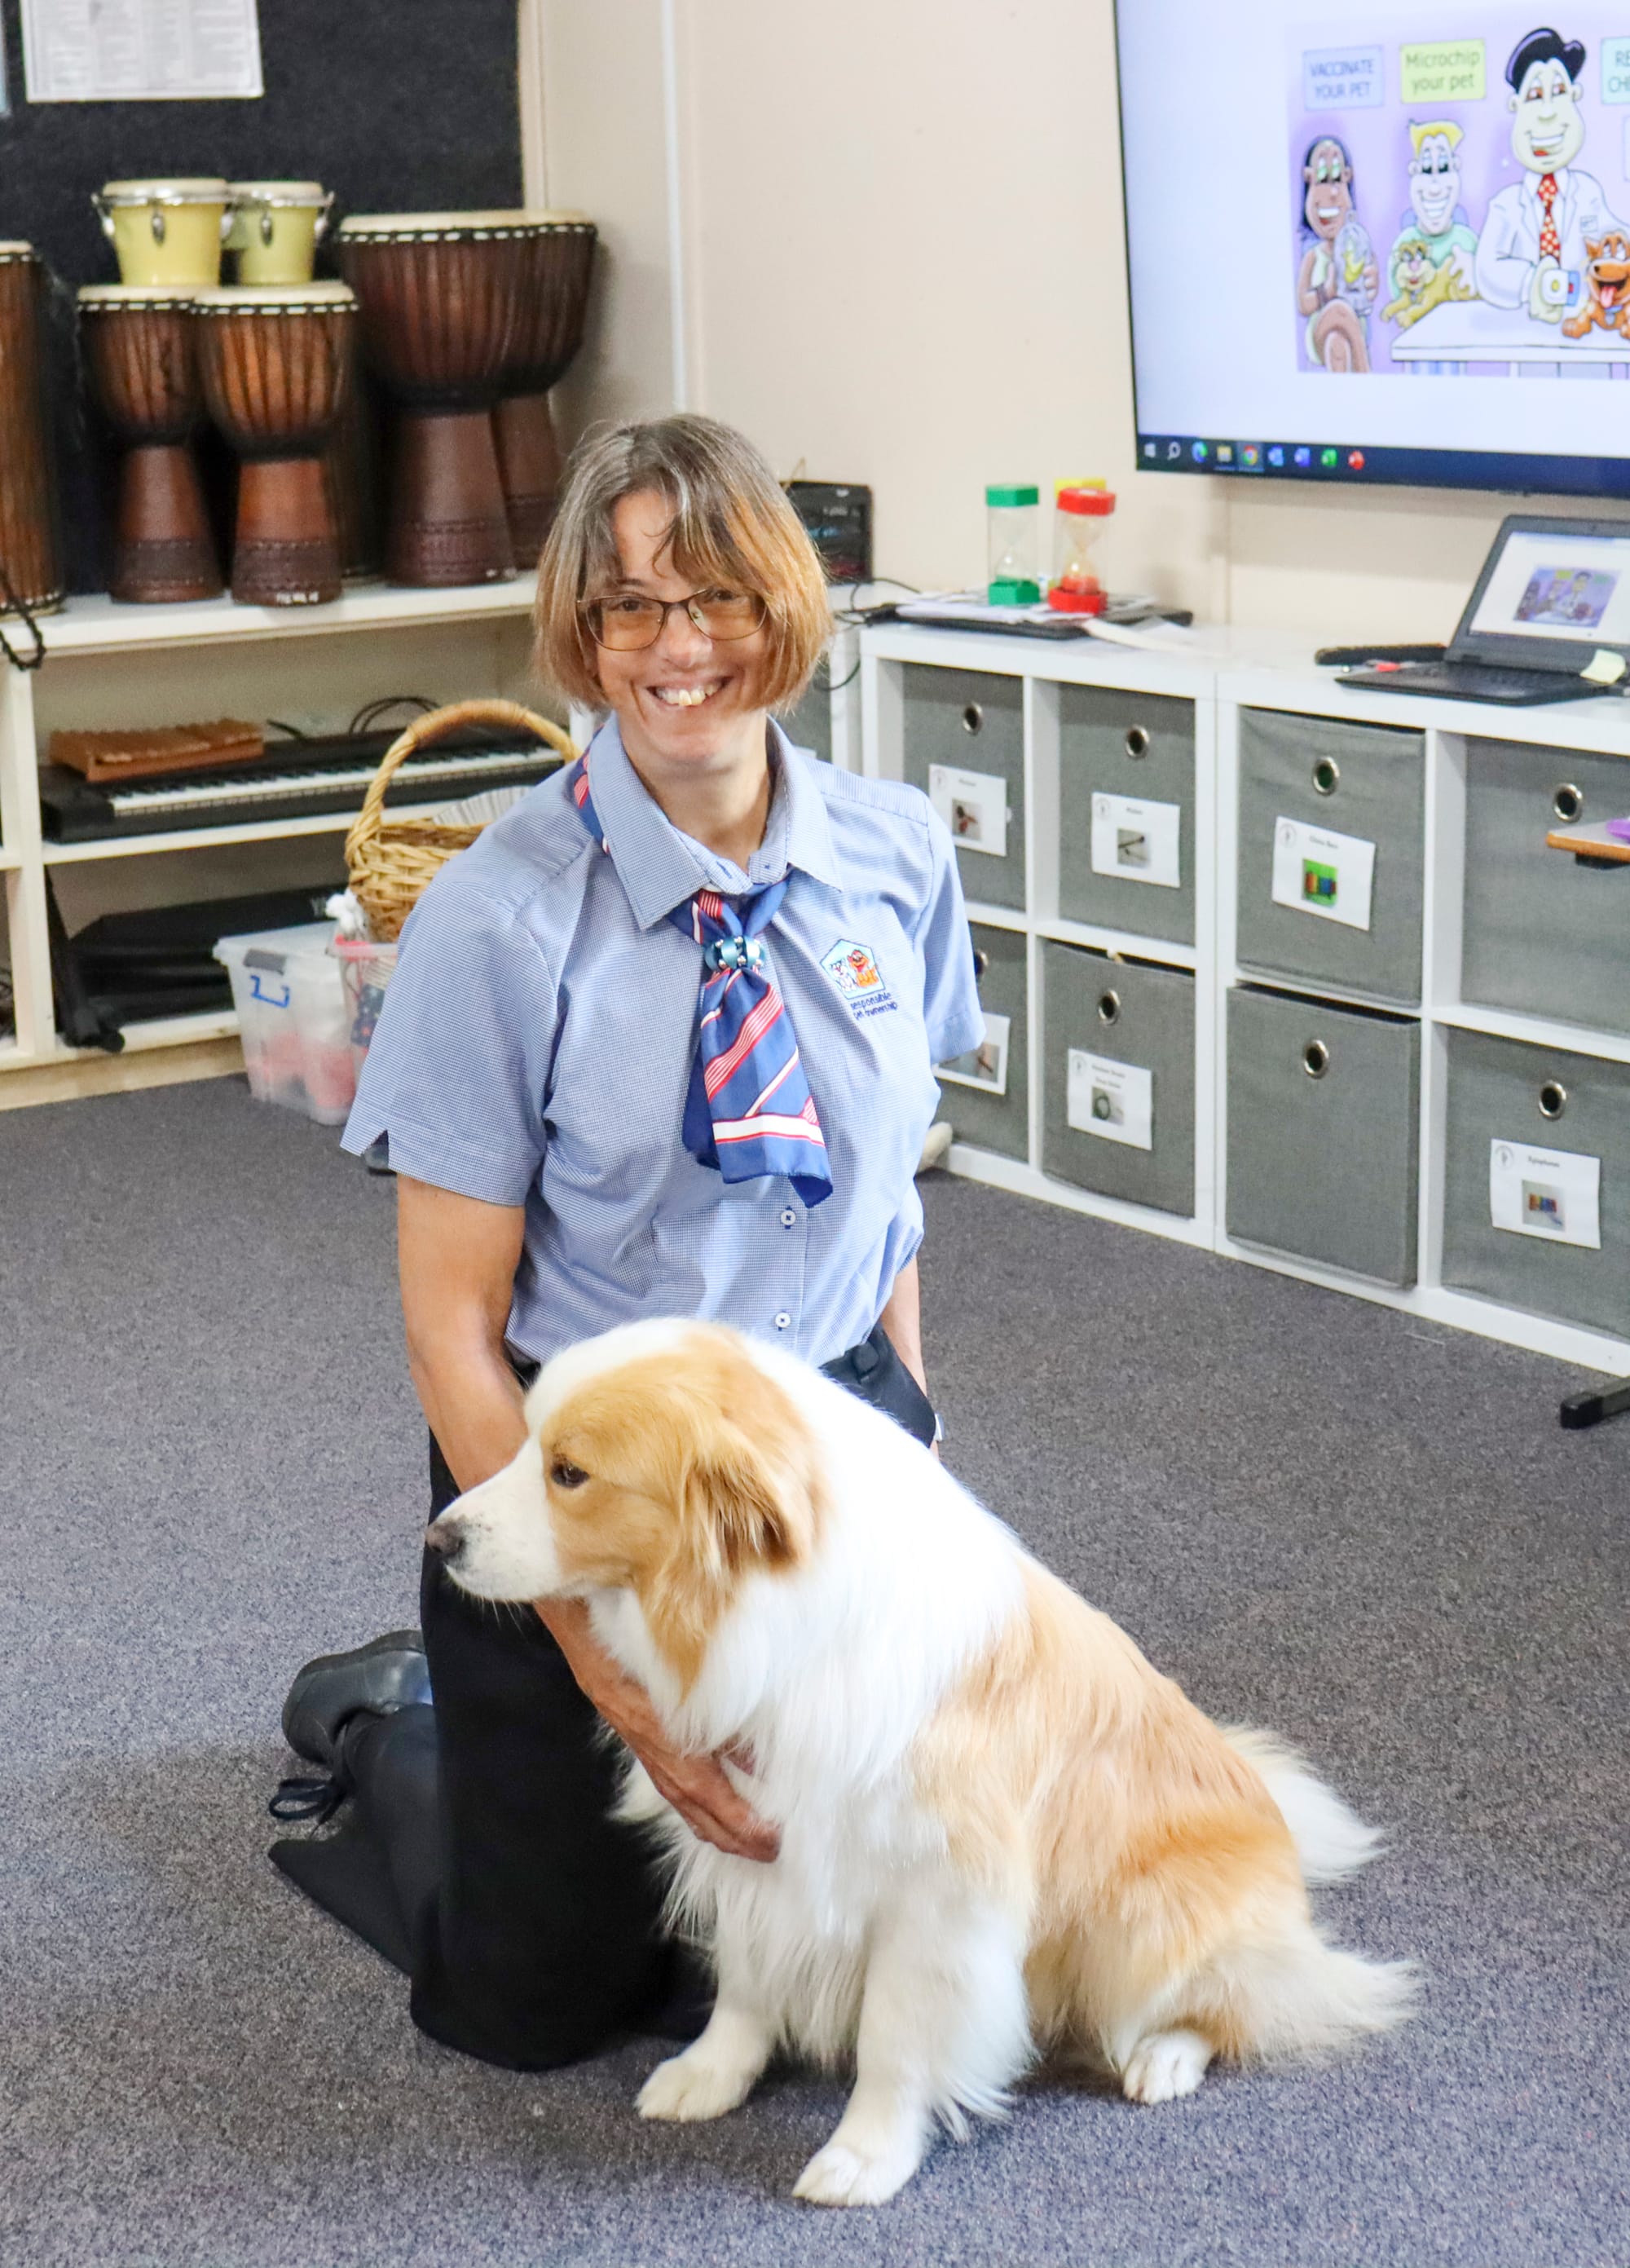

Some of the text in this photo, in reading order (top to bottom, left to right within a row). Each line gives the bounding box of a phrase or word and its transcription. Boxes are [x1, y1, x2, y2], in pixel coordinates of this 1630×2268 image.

[1310, 59, 1374, 77] VACCINATE
[1406, 50, 1480, 68] Microchip
[1315, 82, 1371, 98] YOUR PET
[1412, 73, 1474, 95] your pet
[850, 992, 892, 1010] responsible
